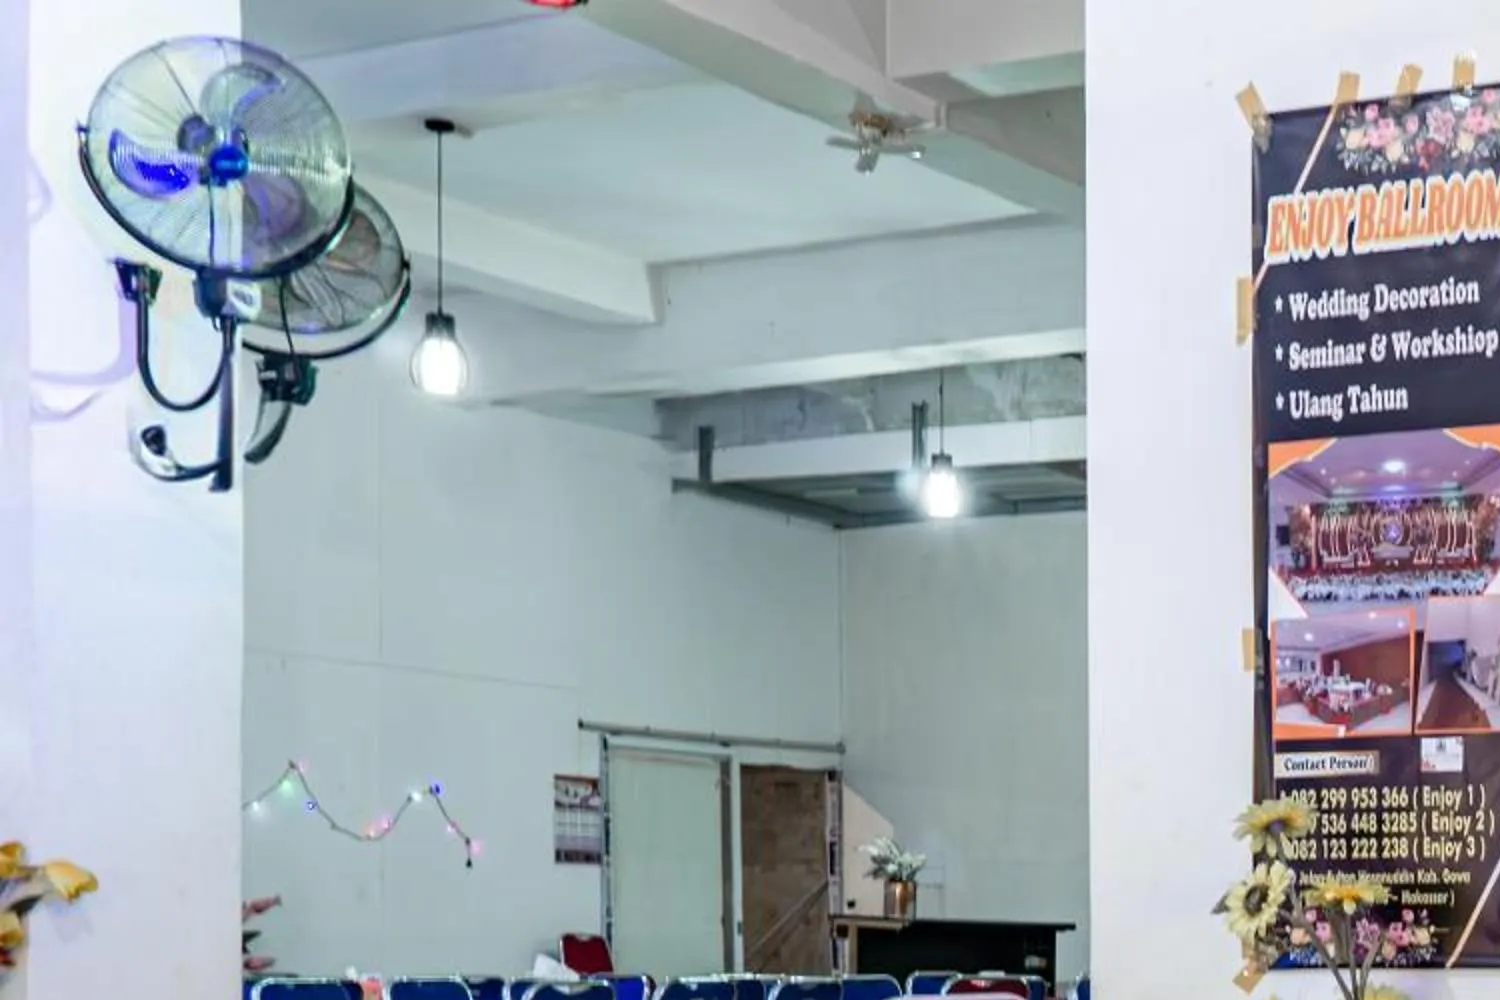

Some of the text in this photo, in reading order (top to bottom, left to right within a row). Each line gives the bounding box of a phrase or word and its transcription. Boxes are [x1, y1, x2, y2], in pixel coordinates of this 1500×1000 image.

[1265, 187, 1355, 263] ENJOY
[1289, 277, 1480, 321] Wedding Decoration
[1289, 325, 1499, 371] Seminar & Workshiop
[1289, 384, 1408, 422] Ulang Tahun
[1284, 756, 1326, 771] Contact
[1321, 787, 1347, 809] 299
[1351, 786, 1377, 809] 953
[1381, 786, 1408, 808] 366
[1423, 784, 1463, 811] Enjoy
[1467, 784, 1473, 806] 1
[1321, 813, 1347, 835] 536
[1351, 812, 1377, 834] 448
[1381, 811, 1417, 833] 3285
[1432, 810, 1471, 837] Enjoy
[1475, 810, 1484, 832] 2
[1322, 838, 1347, 859] 123
[1351, 838, 1377, 859] 222
[1381, 836, 1408, 858] 238
[1423, 836, 1463, 862] Enjoy
[1466, 836, 1475, 857] 3
